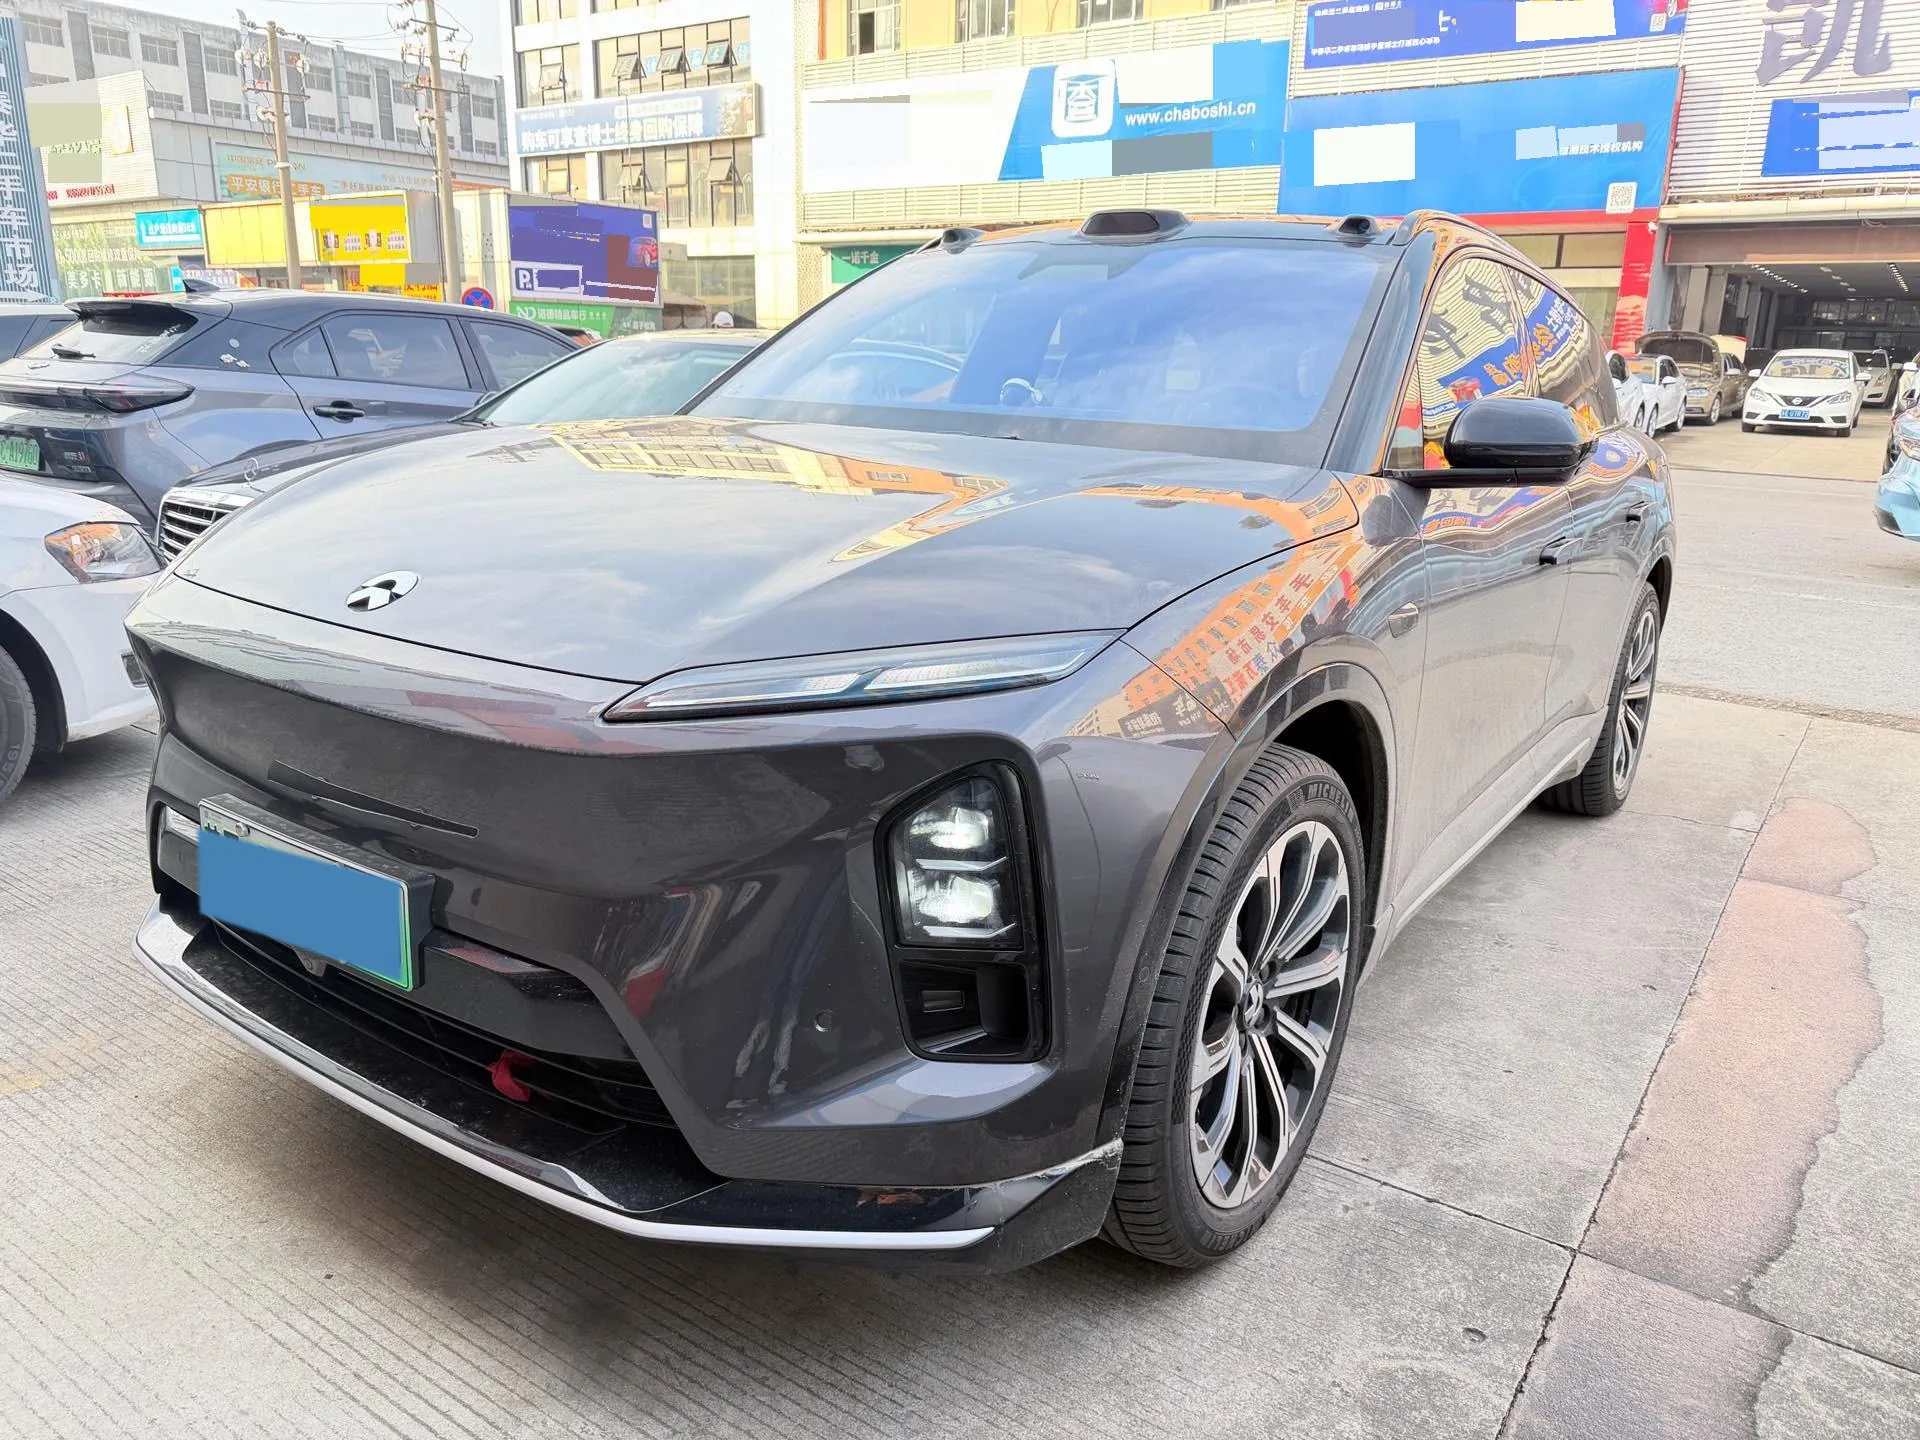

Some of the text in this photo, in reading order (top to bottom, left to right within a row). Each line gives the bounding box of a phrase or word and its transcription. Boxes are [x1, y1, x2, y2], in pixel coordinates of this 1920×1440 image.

[1124, 101, 1256, 126] www.chaboshi.cn
[842, 250, 880, 265] 一诺千金
[1307, 782, 1355, 823] MICHELIN
